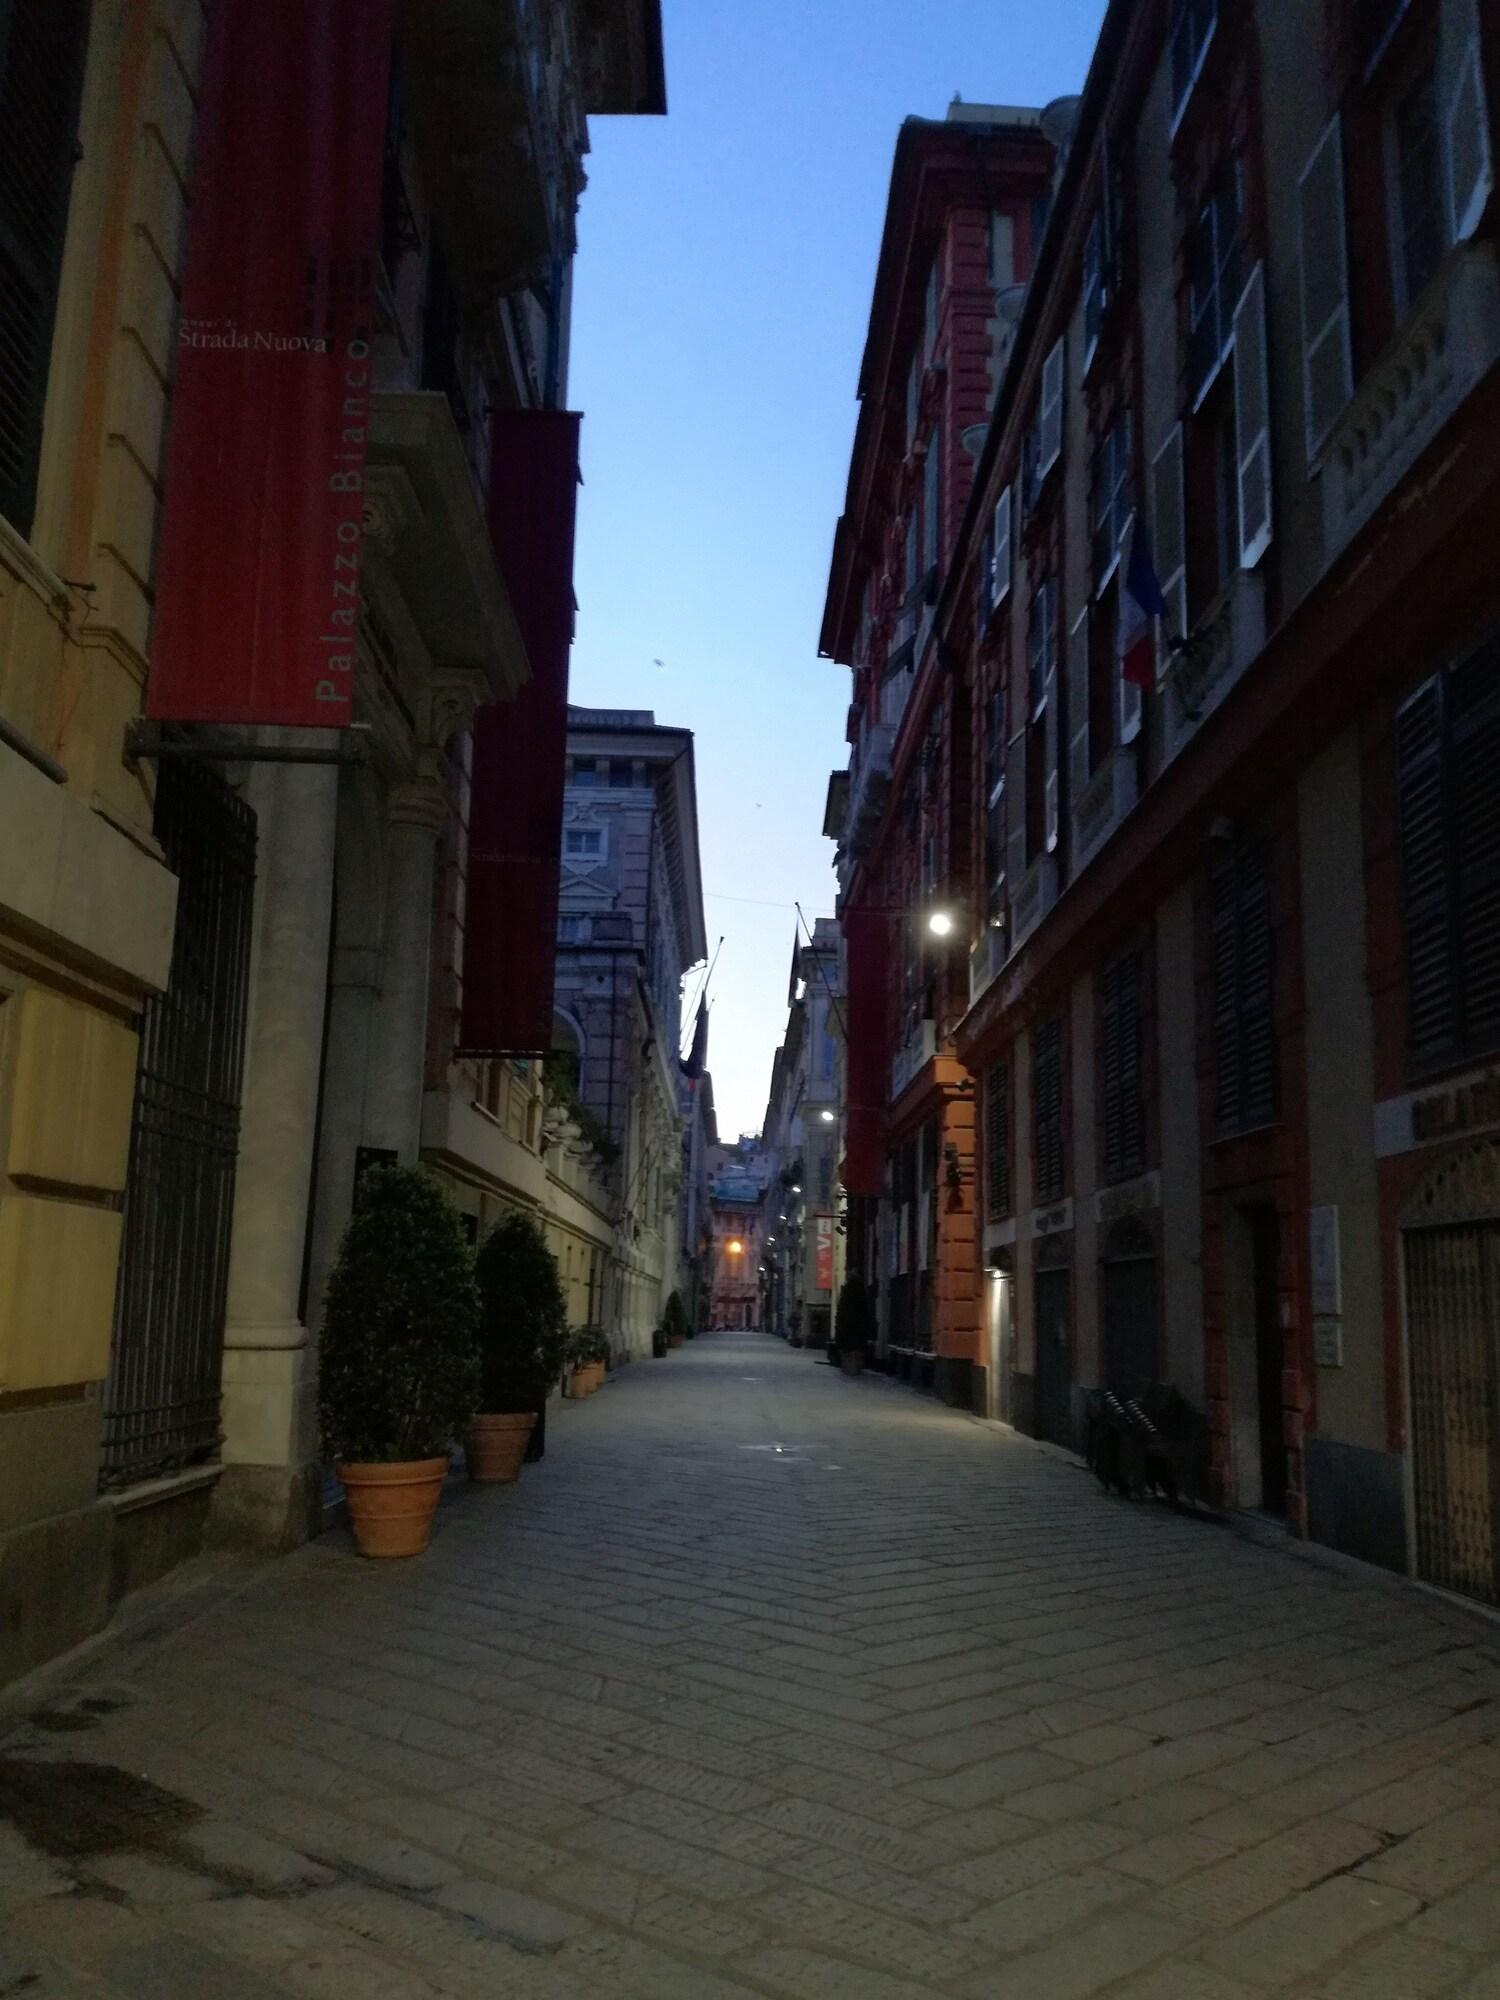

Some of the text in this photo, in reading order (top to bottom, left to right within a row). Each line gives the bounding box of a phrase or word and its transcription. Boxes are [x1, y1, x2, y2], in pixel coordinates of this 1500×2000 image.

[178, 327, 328, 353] Strada Nuova
[315, 338, 370, 703] Palazzo Bianco
